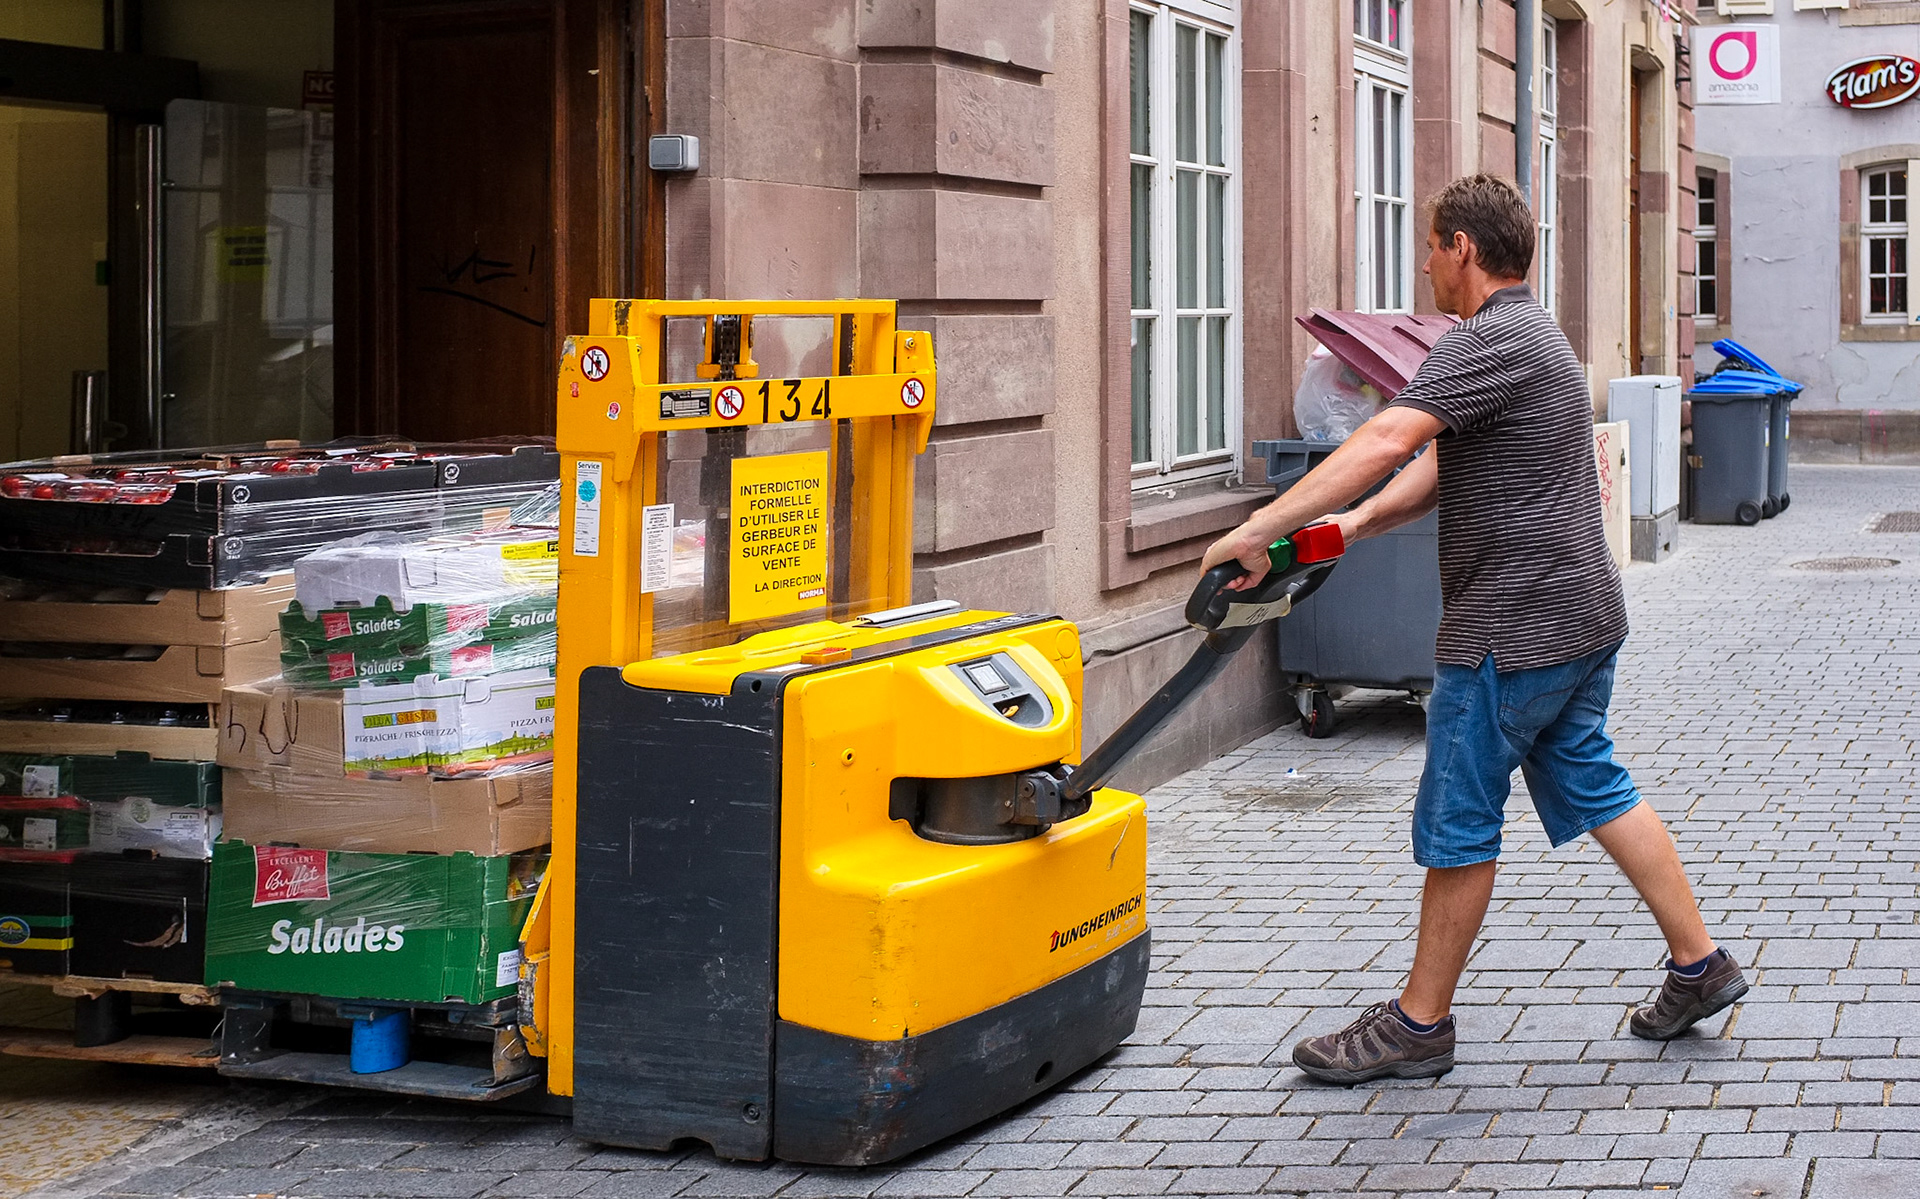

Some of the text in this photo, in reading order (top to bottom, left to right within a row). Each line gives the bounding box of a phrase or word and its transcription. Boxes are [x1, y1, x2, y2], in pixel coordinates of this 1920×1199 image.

[1708, 83, 1759, 92] amazonia
[1831, 57, 1915, 104] Flam's
[758, 378, 832, 424] 134
[577, 462, 600, 470] Service
[740, 478, 820, 496] INTERDICTION
[750, 494, 812, 511] FORMELLE
[739, 508, 820, 528] D'UTILISER LE
[742, 524, 818, 543] GERBEUR EN
[742, 539, 816, 558] SURFACE DE
[762, 556, 801, 571] VENTE
[755, 573, 822, 593] LA DIRECTION
[799, 588, 824, 600] NORMA
[355, 617, 401, 635] Salades
[508, 609, 556, 628] Salad
[359, 659, 405, 677] Salades
[510, 718, 537, 728] PIZZA
[269, 855, 314, 866] EXCELLENT
[265, 865, 320, 898] Buffet
[1049, 892, 1142, 954] JUNGHEINRICH
[267, 916, 405, 955] Salades
